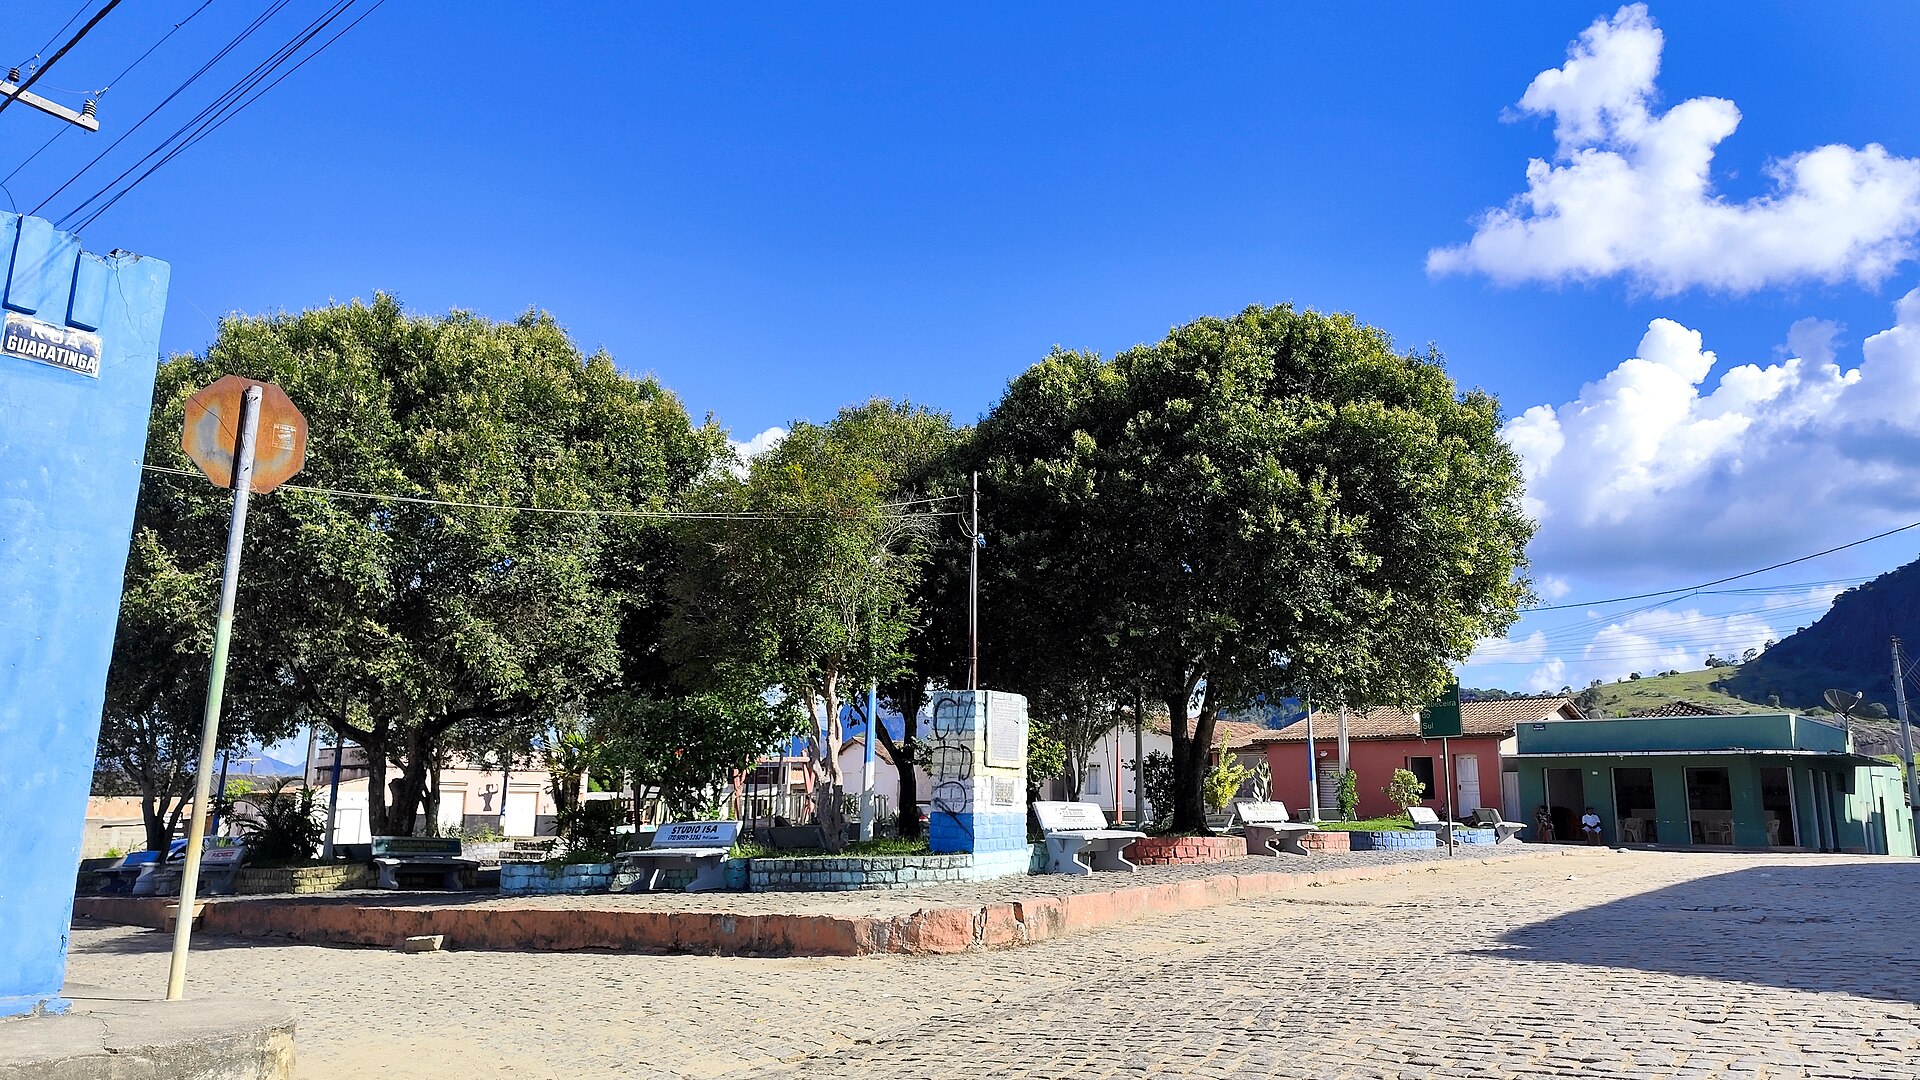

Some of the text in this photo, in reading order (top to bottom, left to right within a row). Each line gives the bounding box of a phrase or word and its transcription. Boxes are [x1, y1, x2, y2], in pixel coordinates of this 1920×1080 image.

[6, 334, 97, 374] GUARATINGA
[1425, 699, 1457, 708] abeceira
[1422, 721, 1434, 730] Sul
[671, 825, 718, 834] STUDIO ISA
